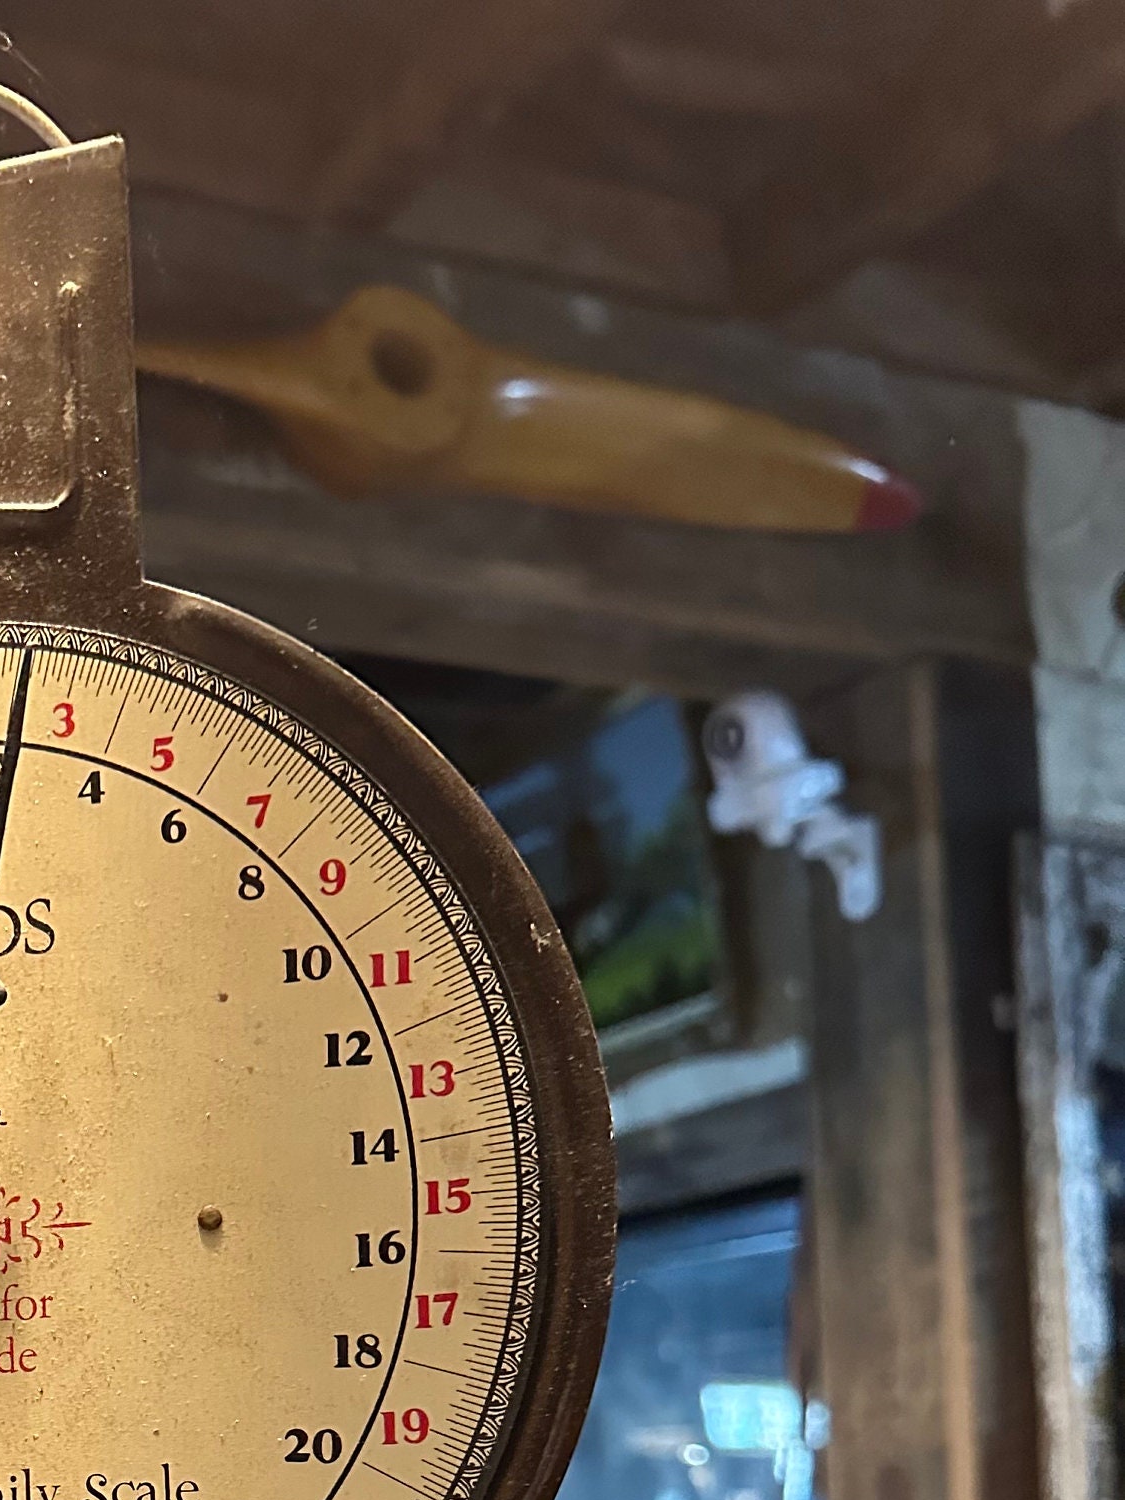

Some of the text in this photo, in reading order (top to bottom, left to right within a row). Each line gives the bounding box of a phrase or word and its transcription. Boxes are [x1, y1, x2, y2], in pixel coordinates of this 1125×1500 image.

[54, 702, 75, 738] 3
[152, 736, 175, 772] 5
[78, 771, 105, 804] 4
[161, 809, 186, 843] 6
[247, 794, 271, 828] 7
[239, 865, 264, 900] 8
[320, 859, 347, 895] 9
[283, 946, 331, 983] 10
[371, 950, 411, 988] 11
[324, 1031, 372, 1067] 12
[411, 1060, 455, 1098] 13
[350, 1129, 399, 1165] 14
[427, 1178, 471, 1214] 15
[355, 1230, 405, 1268] 16
[0, 1284, 53, 1322] for
[417, 1292, 458, 1329] 17
[334, 1334, 382, 1368] 18
[383, 1409, 429, 1445] 19
[285, 1429, 342, 1464] 20
